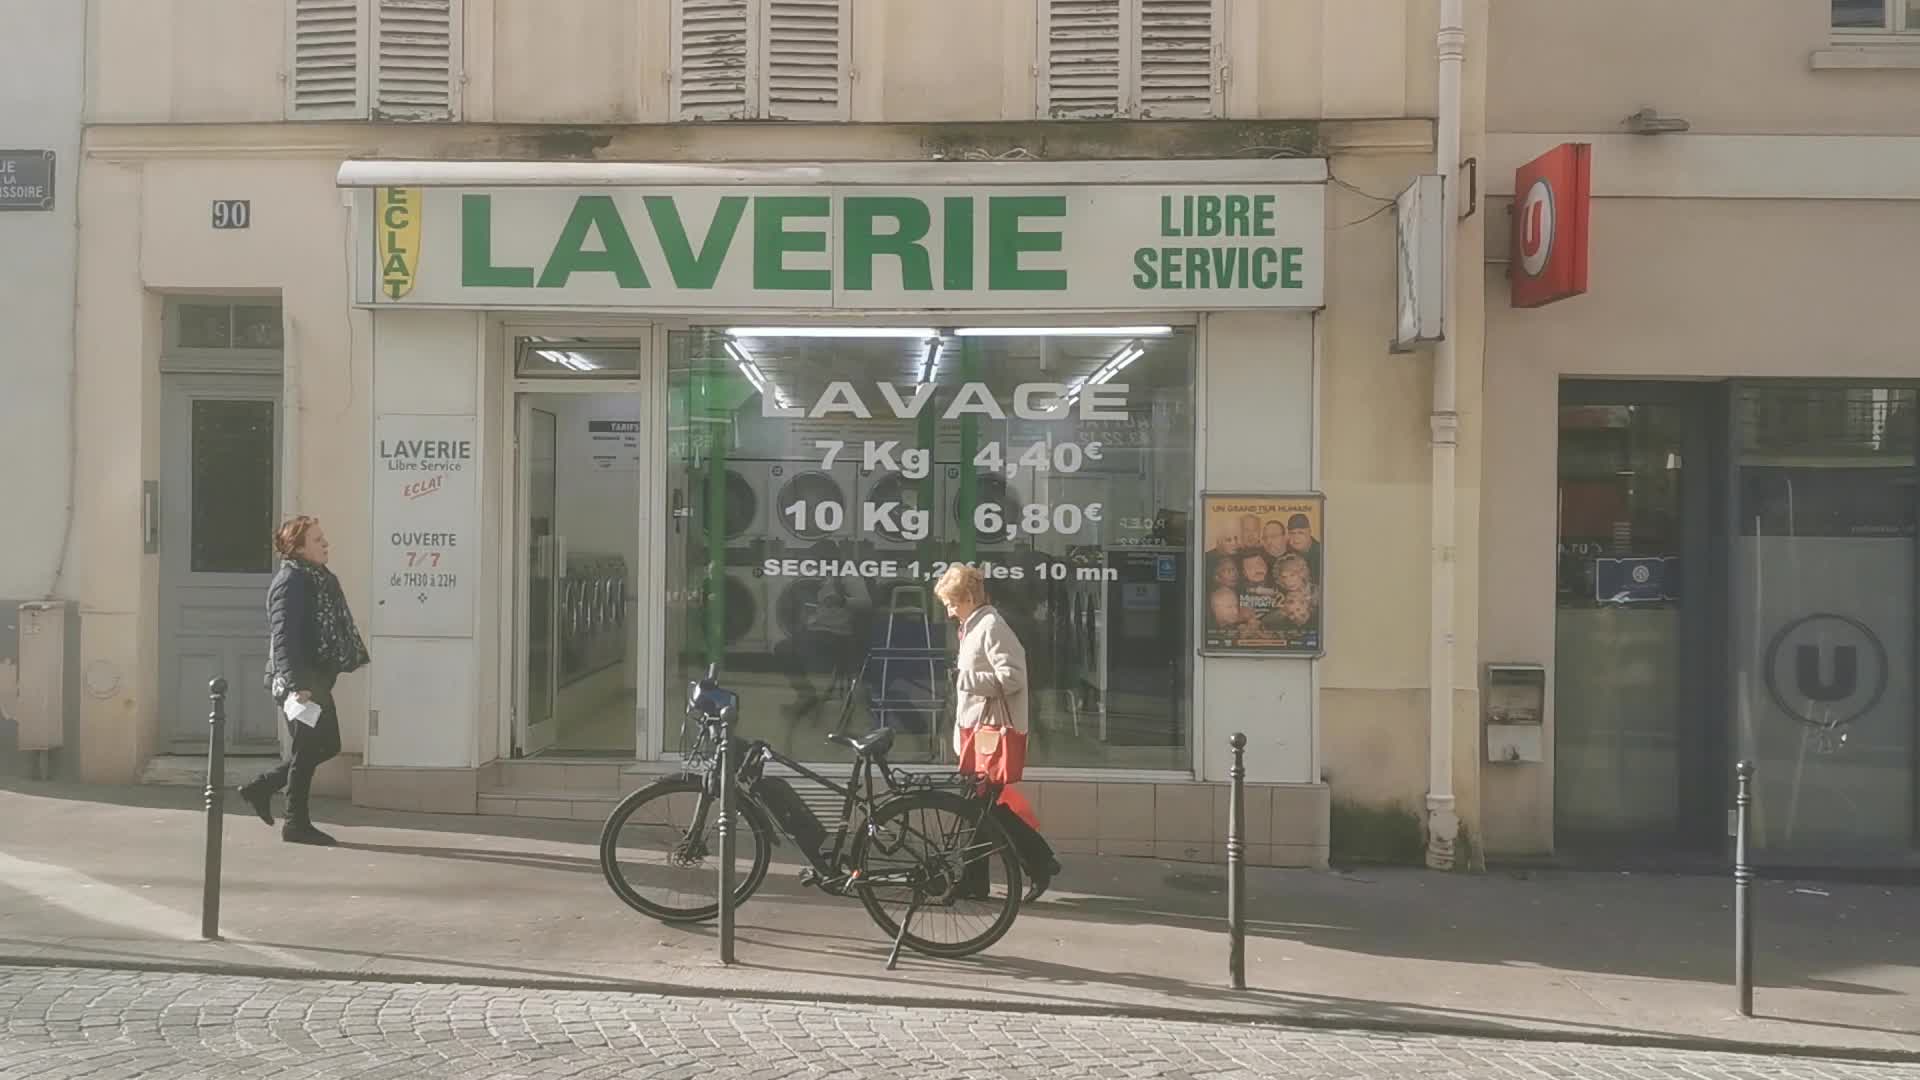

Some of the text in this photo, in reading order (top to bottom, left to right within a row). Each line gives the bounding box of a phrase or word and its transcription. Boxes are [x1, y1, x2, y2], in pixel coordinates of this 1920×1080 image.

[213, 202, 249, 228] 90
[1160, 195, 1276, 237] LIBRE
[384, 186, 410, 299] ECLAT
[461, 194, 1068, 291] LAVERIE
[1132, 246, 1304, 290] SERVICE
[761, 381, 1130, 421] LAVAGE
[380, 440, 471, 459] LAVERIE
[388, 460, 462, 471] Libre Service
[815, 440, 1104, 480] 7 Kg 4,40€
[404, 475, 443, 497] ECLAT
[391, 533, 457, 547] OUVERTE
[785, 500, 1104, 541] 10 Kg 6,80€
[390, 573, 457, 588] de 7H30 à 22H
[763, 559, 898, 578] SECHAGE
[984, 560, 1025, 580] les
[1034, 562, 1067, 580] 10
[1076, 567, 1118, 581] mn
[1797, 645, 1857, 702] U
